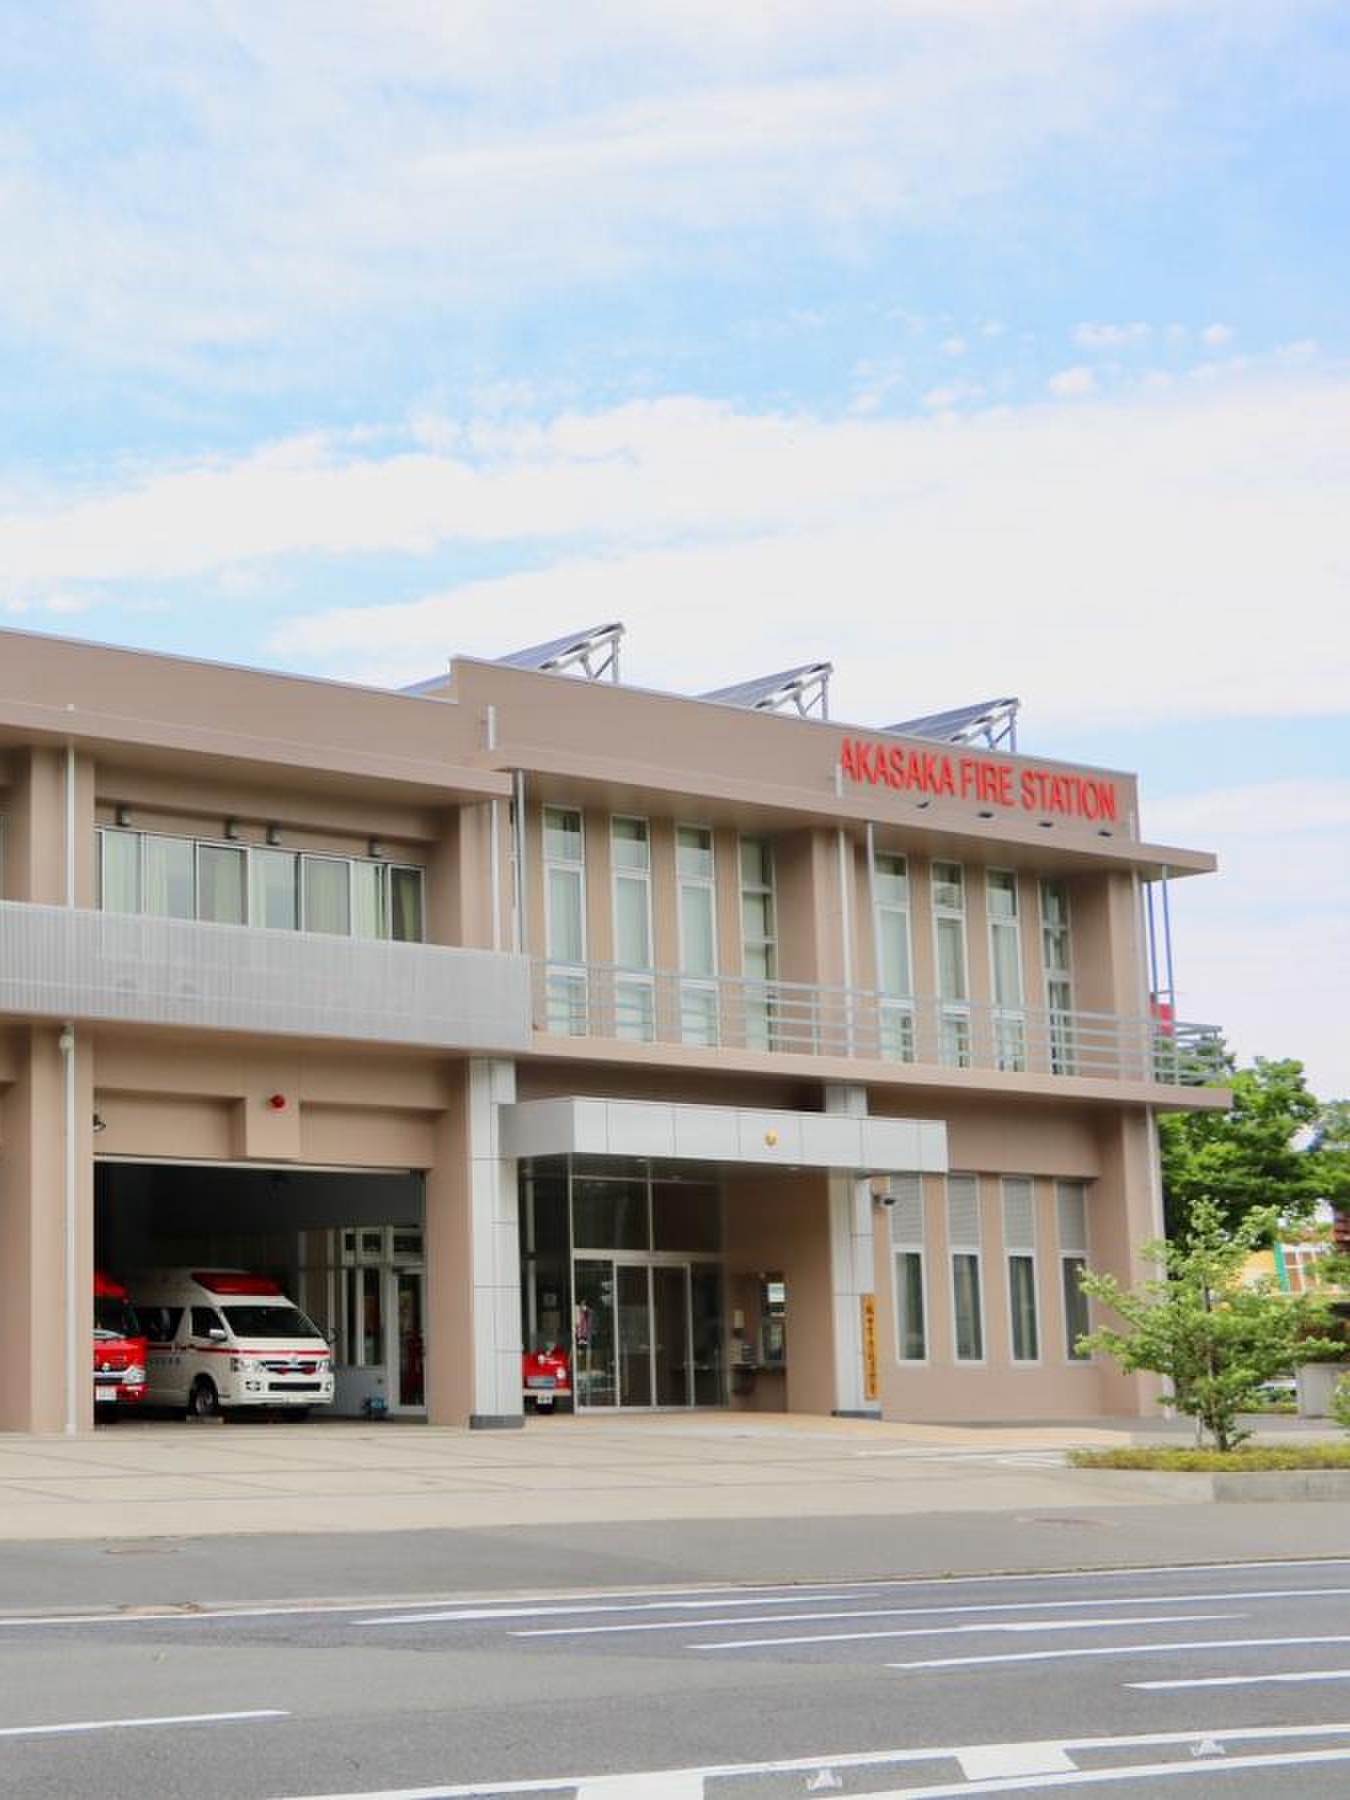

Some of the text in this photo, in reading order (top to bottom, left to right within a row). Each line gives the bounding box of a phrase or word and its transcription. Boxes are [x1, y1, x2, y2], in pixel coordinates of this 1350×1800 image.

[840, 735, 1116, 823] AKASAKA FIRE STATION
